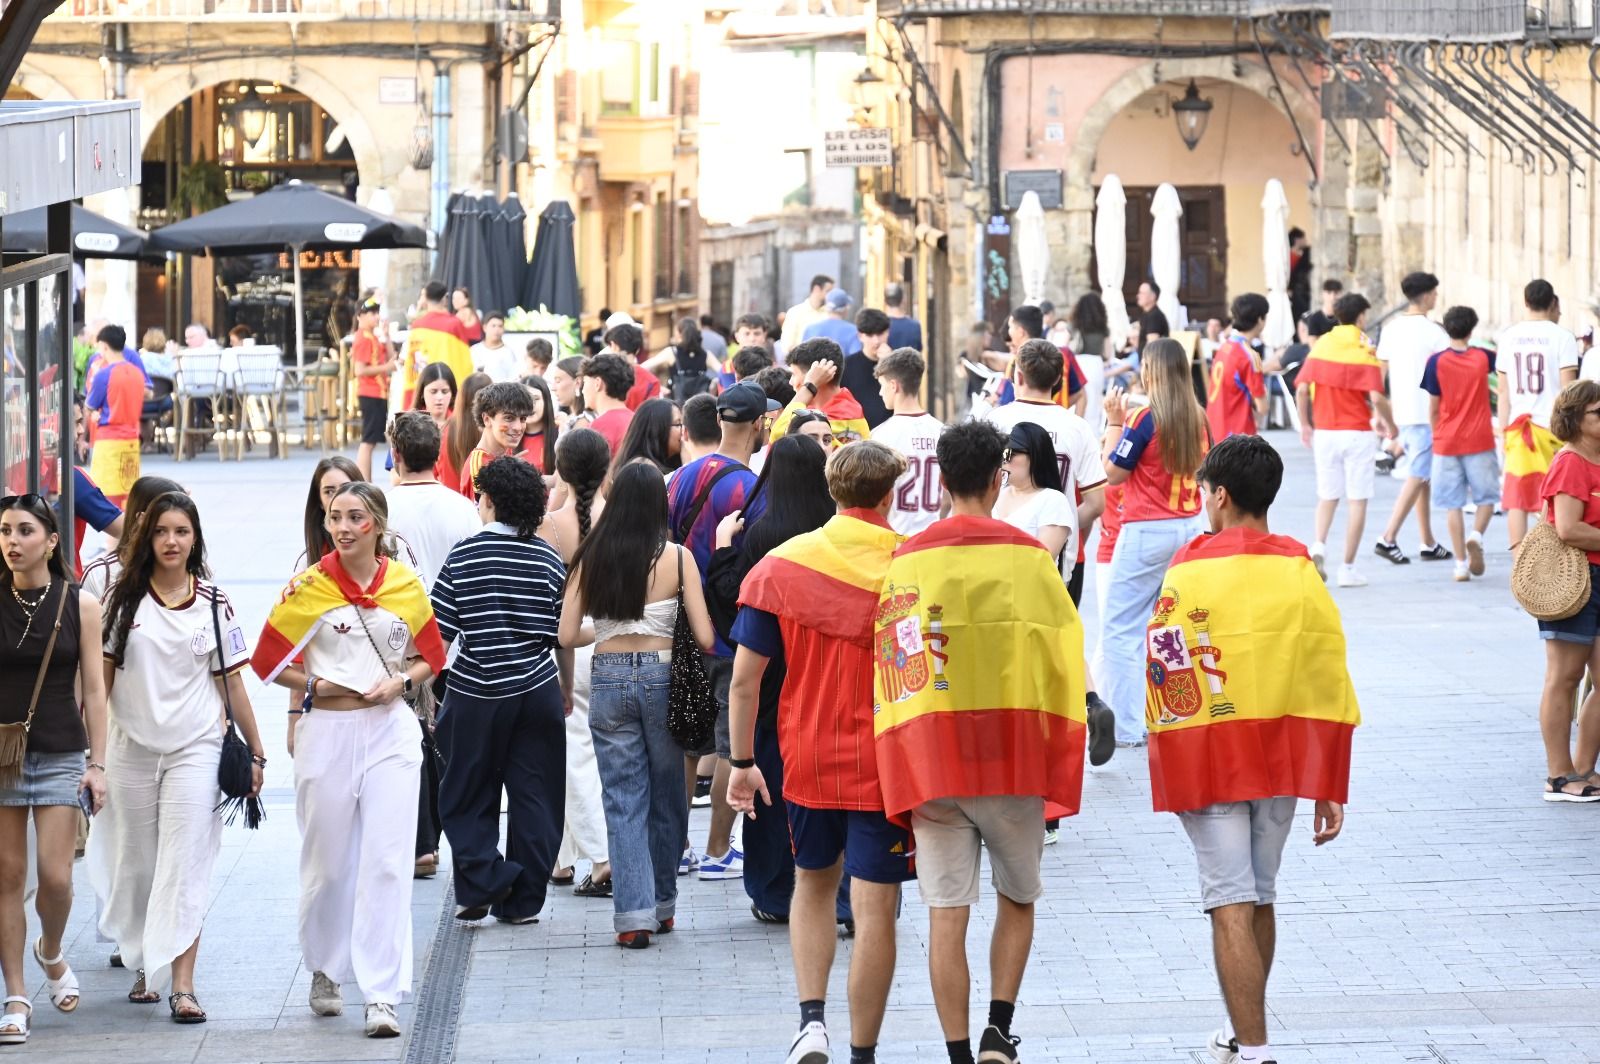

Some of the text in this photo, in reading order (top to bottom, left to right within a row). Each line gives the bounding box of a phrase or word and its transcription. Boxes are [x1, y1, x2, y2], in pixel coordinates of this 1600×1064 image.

[825, 129, 887, 140] LA CASA
[826, 142, 887, 151] DE LOS
[1514, 352, 1545, 394] 18
[911, 437, 936, 450] PEDRI
[897, 454, 943, 513] 20
